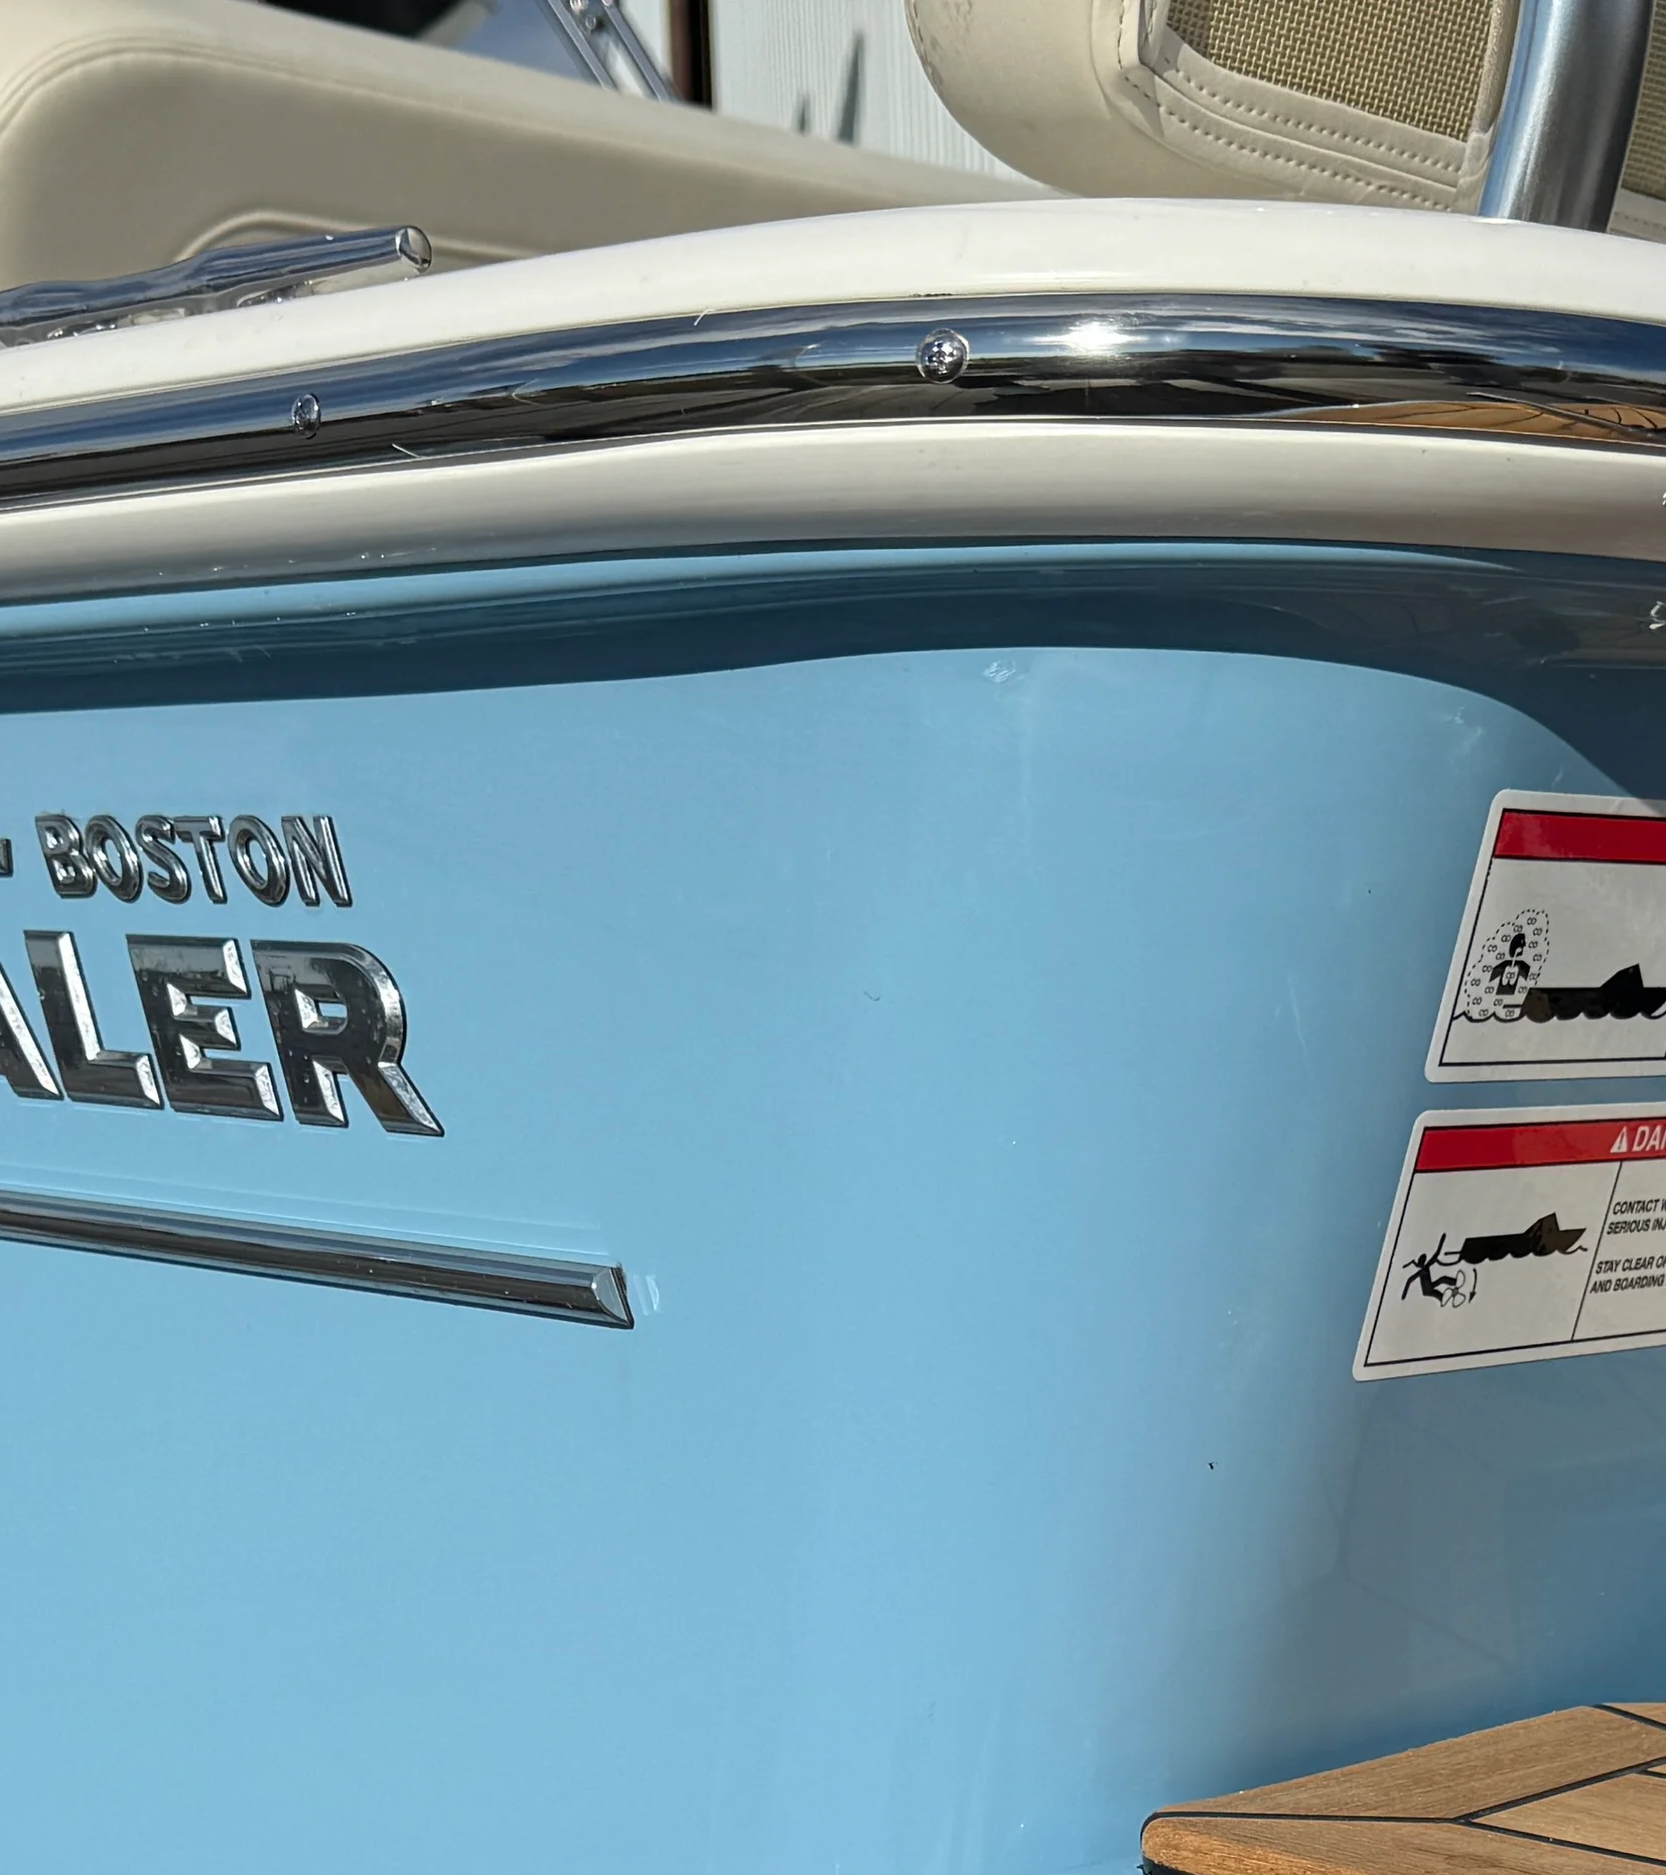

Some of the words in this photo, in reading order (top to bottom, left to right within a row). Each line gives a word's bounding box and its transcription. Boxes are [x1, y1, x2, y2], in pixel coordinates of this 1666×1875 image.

[34, 814, 353, 907] BOSTON
[1613, 1199, 1660, 1215] CONTACT
[1607, 1219, 1651, 1235] SERIOUS
[1595, 1259, 1621, 1274] STAY
[1622, 1256, 1654, 1272] CLEAR
[1590, 1280, 1612, 1294] AND
[1613, 1274, 1665, 1292] BOARDING
